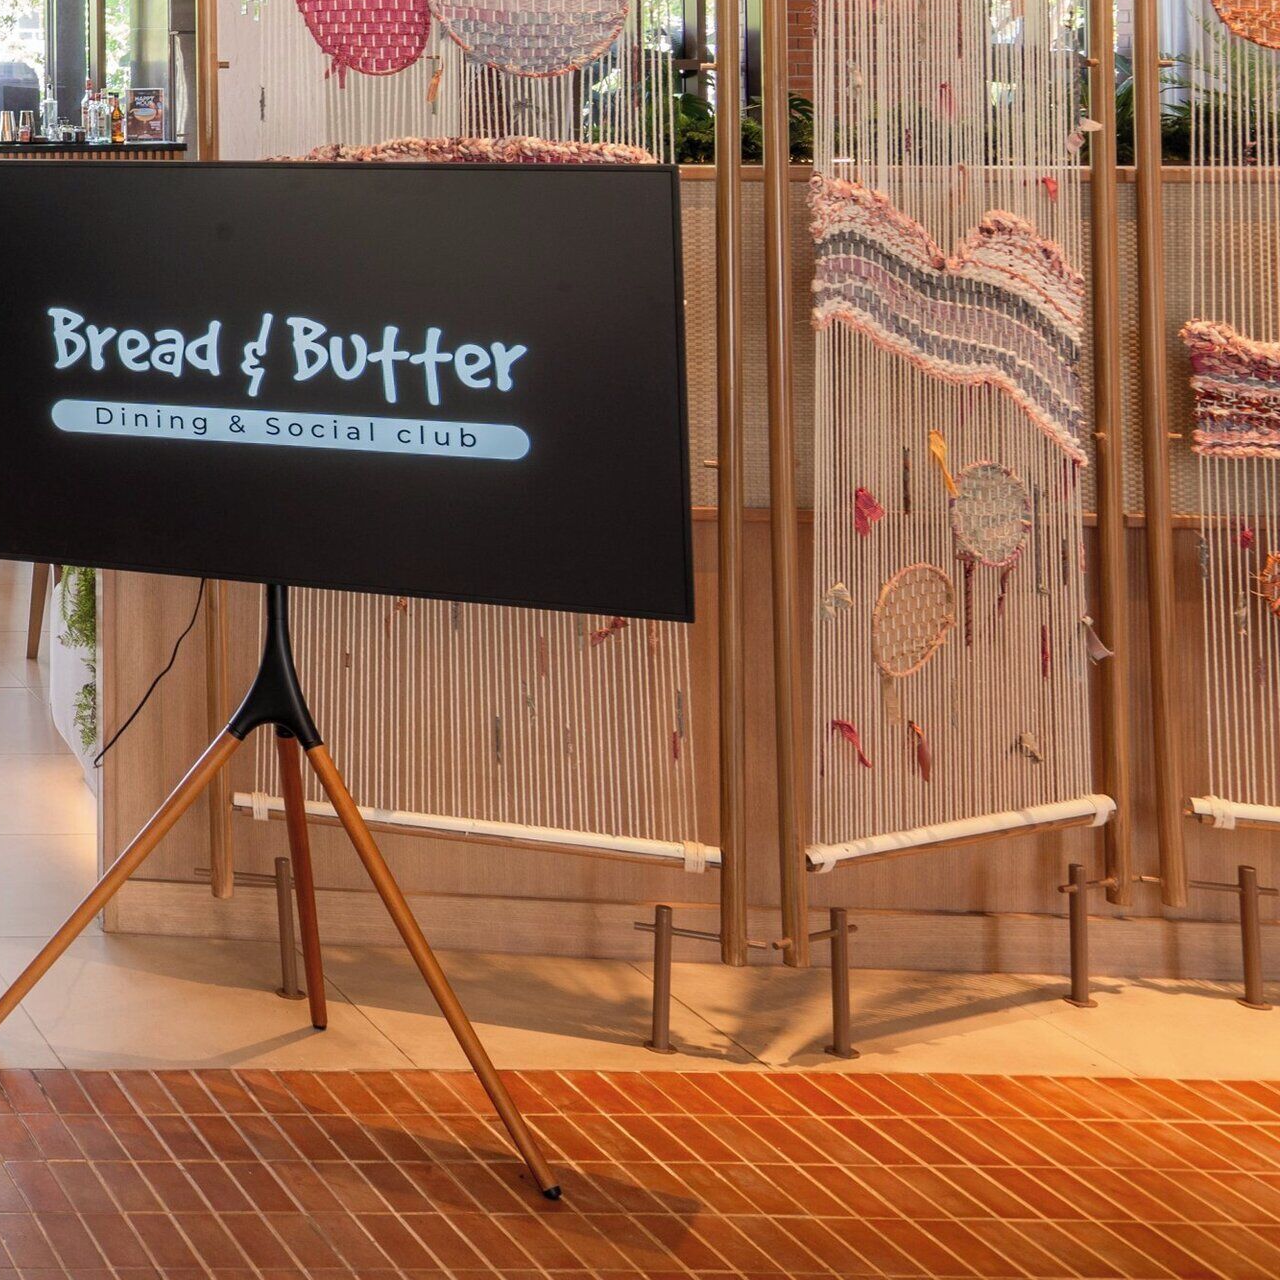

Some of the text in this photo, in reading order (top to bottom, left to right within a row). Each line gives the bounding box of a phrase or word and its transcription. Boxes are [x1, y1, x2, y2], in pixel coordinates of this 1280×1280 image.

[47, 307, 528, 406] Bread & Butter
[95, 406, 478, 448] Dining & Social club
